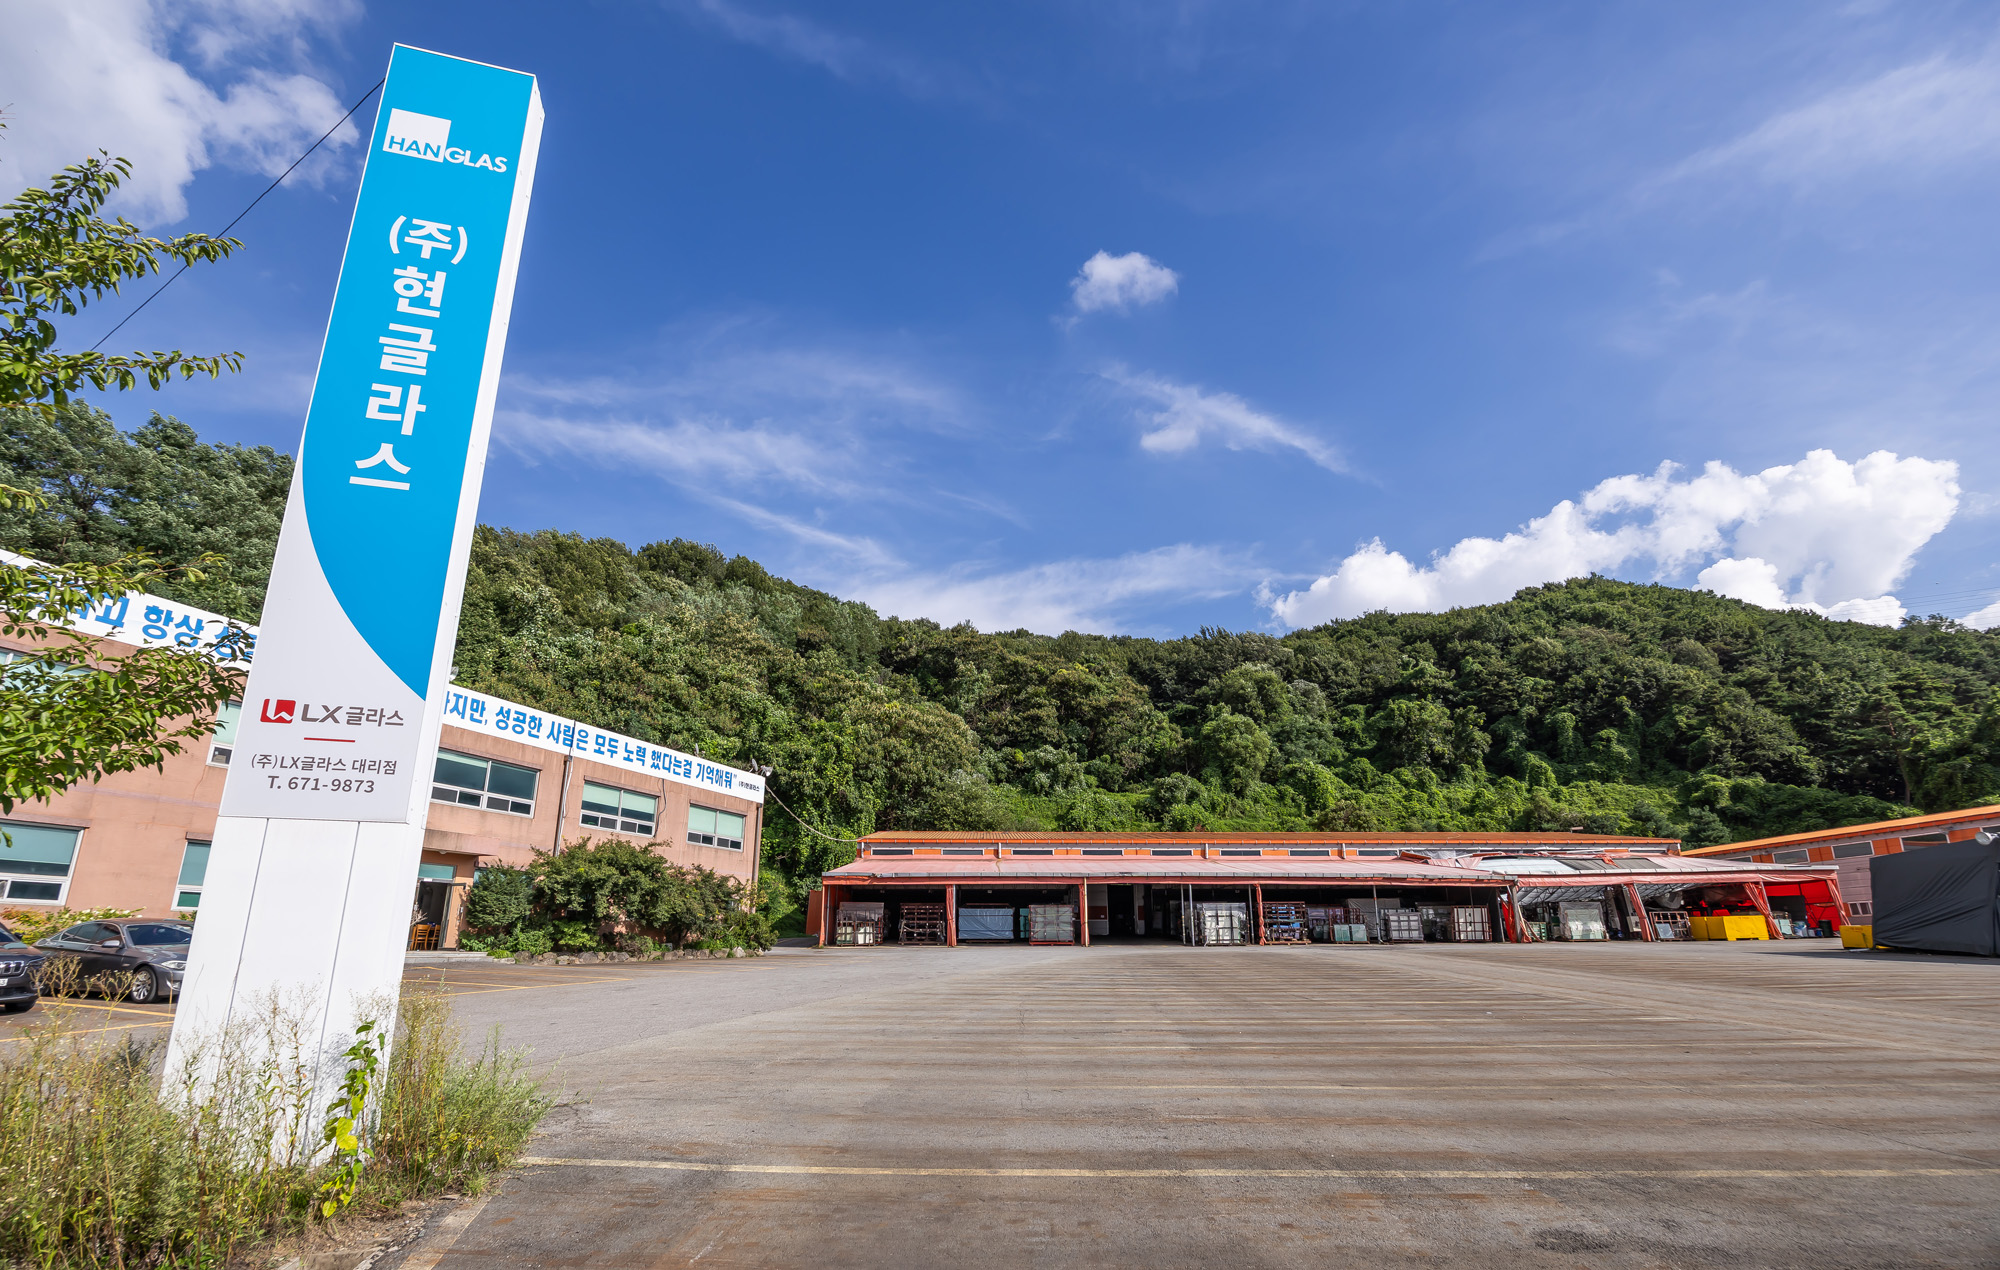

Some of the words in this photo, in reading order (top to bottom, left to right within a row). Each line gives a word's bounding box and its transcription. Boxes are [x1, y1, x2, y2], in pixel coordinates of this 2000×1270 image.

[388, 134, 508, 173] HANGLAS
[142, 605, 205, 648] 항상
[495, 705, 543, 739] 성공한
[546, 720, 589, 752] 사람은
[593, 733, 619, 759] 모두
[623, 741, 647, 767] 노력
[650, 749, 692, 779] 했다는걸
[251, 753, 347, 772] (주)LX글라스
[351, 758, 397, 775] 대리점
[267, 775, 282, 789] T.
[288, 776, 375, 793] 671-9873
